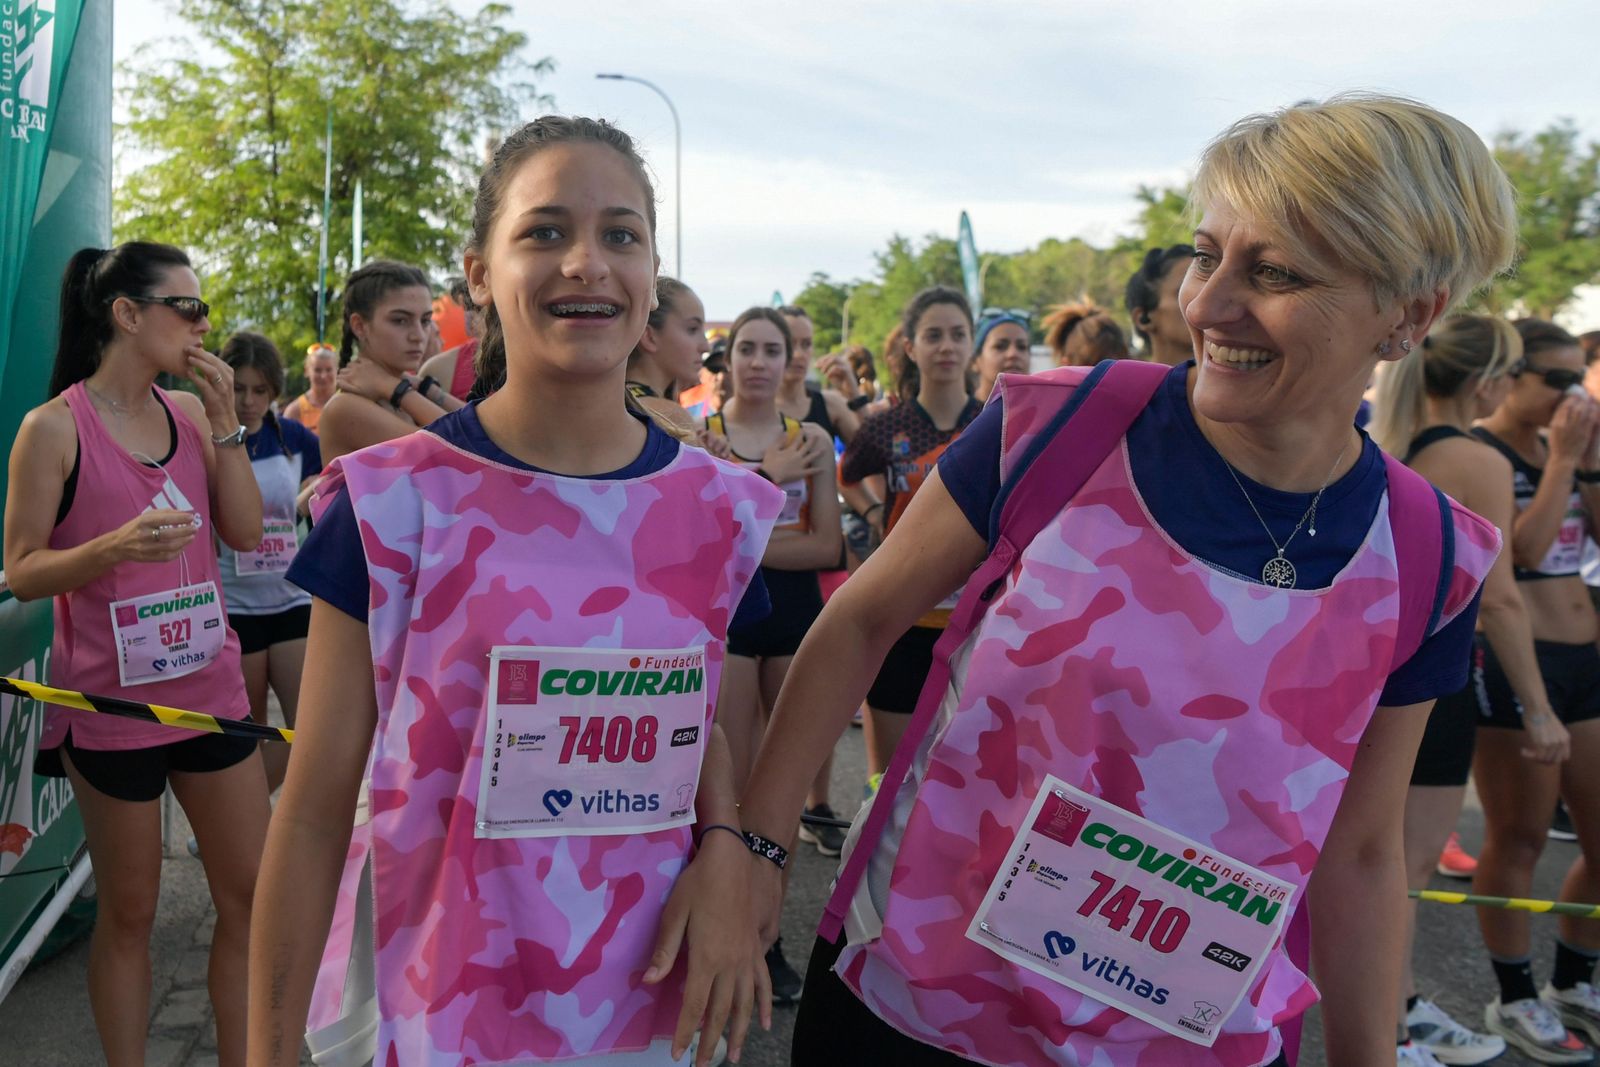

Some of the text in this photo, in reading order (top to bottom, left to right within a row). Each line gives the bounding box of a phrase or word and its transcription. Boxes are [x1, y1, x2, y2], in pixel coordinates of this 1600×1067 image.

[0, 0, 12, 91] fundac
[264, 525, 293, 534] VIRAN
[138, 591, 215, 619] COVIRAN
[159, 617, 191, 646] 527
[171, 651, 205, 668] vithas
[540, 667, 703, 696] COVIRAN
[498, 718, 502, 729] 1
[496, 733, 502, 743] 2
[518, 733, 546, 742] olimpo
[558, 715, 659, 764] 7408
[673, 730, 697, 743] 42K
[494, 747, 501, 758] 3
[492, 762, 499, 772] 4
[491, 776, 498, 787] 5
[581, 789, 660, 814] vithas
[1024, 843, 1031, 852] 1
[1017, 854, 1025, 864] 2
[1011, 867, 1019, 877] 3
[1040, 865, 1068, 881] olimpo
[1080, 822, 1282, 926] COVIRAN
[1199, 855, 1286, 902] Fundación
[1004, 879, 1012, 889] 4
[998, 891, 1007, 901] 5
[1076, 870, 1191, 954] 7410
[1207, 946, 1248, 969] 42K
[1082, 951, 1170, 1005] vithas
